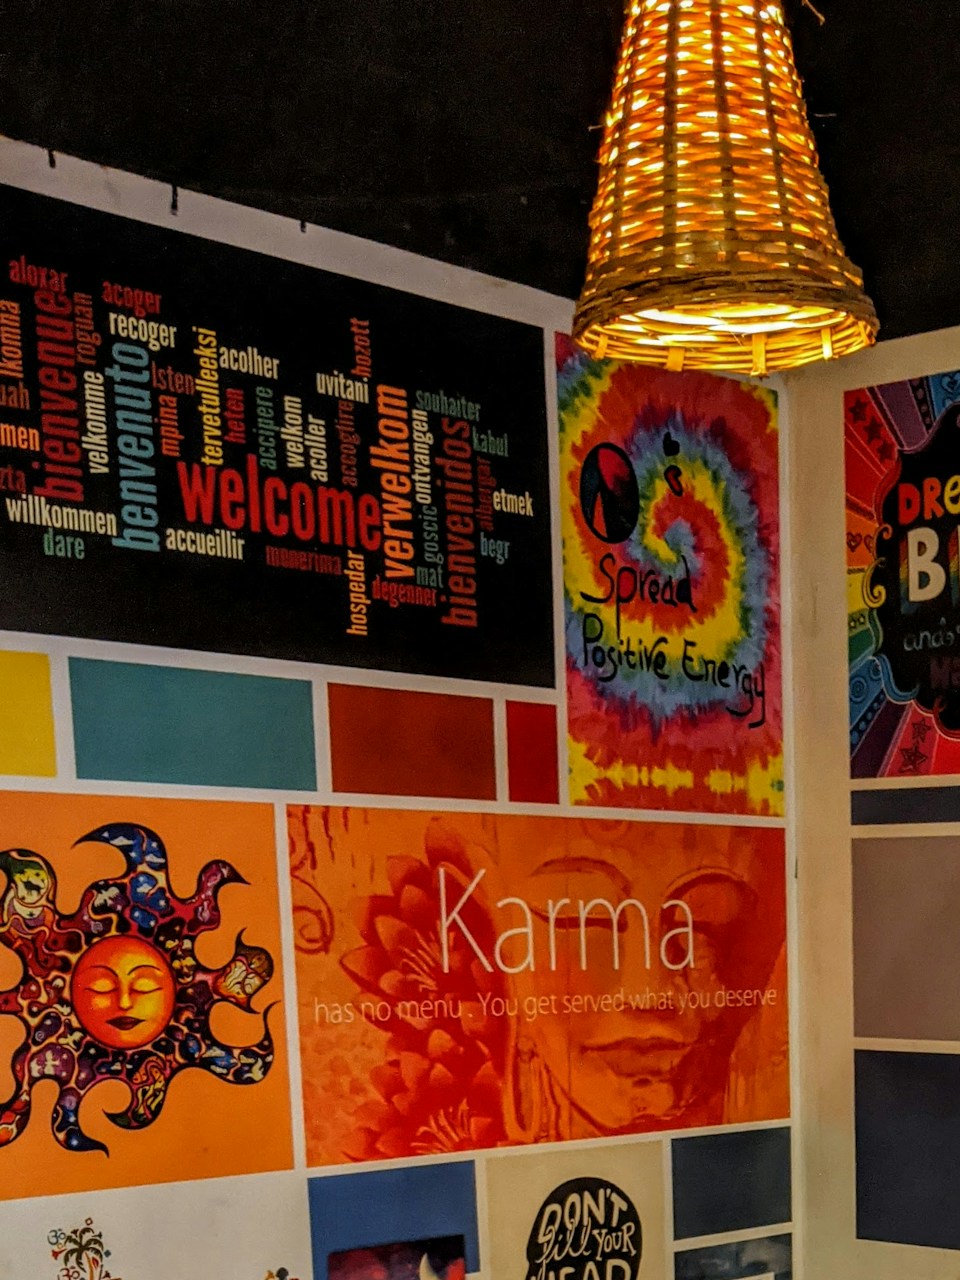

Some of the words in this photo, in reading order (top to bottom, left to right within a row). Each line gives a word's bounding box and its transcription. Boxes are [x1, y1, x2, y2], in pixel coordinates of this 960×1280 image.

[109, 312, 177, 351] recoger
[219, 346, 280, 380] acolher
[34, 289, 84, 502] bienvenue
[81, 371, 109, 474] velkomme
[192, 327, 223, 466] tervetulleeksi
[316, 372, 369, 404] uvitani
[104, 342, 160, 552] benvenuto
[281, 394, 304, 468] welkom
[308, 414, 328, 482] acoller
[410, 409, 434, 505] ontvangen
[6, 493, 117, 537] willkommen
[177, 453, 381, 551] welcome
[370, 384, 415, 578] verwelkom
[493, 489, 533, 517] etmek
[44, 528, 85, 560] dare
[166, 527, 245, 560] accueillir
[435, 418, 478, 627] bienvenidos
[346, 550, 372, 636] hospedar
[580, 552, 697, 640] Spread
[581, 614, 671, 683] Positive
[682, 640, 765, 729] Energy
[438, 867, 695, 973] Karma
[315, 996, 354, 1024] has
[361, 1000, 392, 1022] no
[478, 991, 518, 1017] You
[526, 990, 559, 1023] get
[563, 987, 624, 1014] served
[627, 986, 675, 1011] what
[678, 991, 711, 1015] you
[715, 986, 778, 1008] deserve
[538, 1187, 628, 1244] DON'T
[592, 1222, 637, 1261] YOUR
